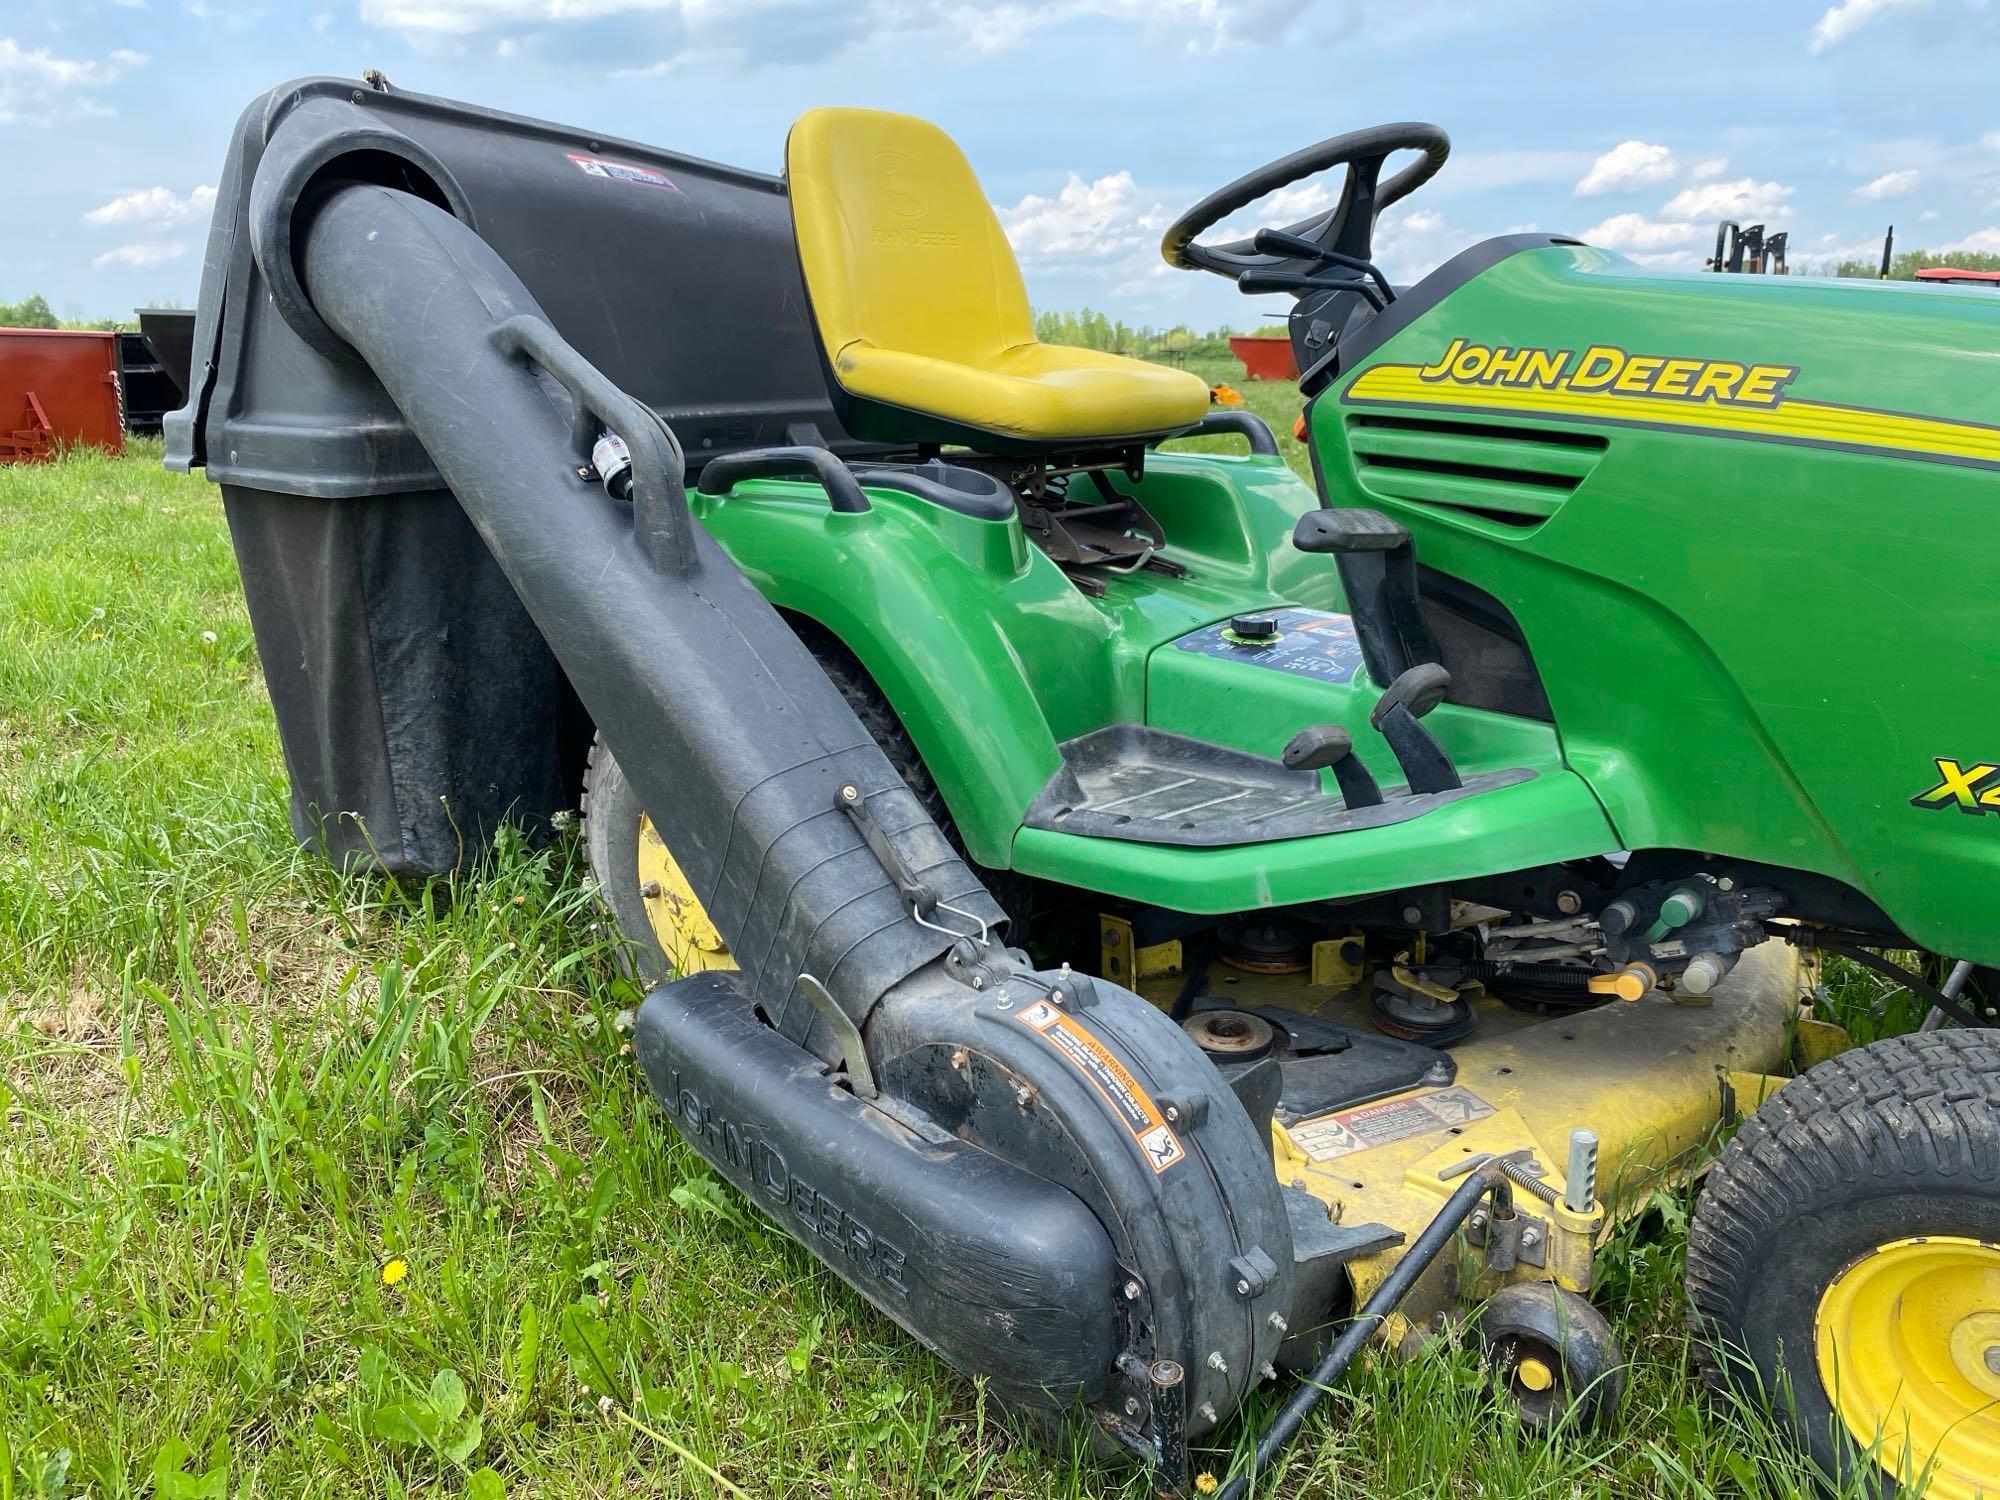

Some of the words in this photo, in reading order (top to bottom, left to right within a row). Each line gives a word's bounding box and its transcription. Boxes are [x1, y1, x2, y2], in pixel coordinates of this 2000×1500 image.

[1421, 339, 1572, 387] JOHN
[1567, 345, 1797, 406] DEERE
[1081, 1045, 1101, 1064] BLADE
[1103, 1065, 1125, 1093] THROWN
[1125, 1092, 1149, 1124] OBJECTS
[1094, 1045, 1135, 1089] WARNING
[1359, 1102, 1408, 1118] DANGER
[664, 1068, 753, 1182] JOHN
[759, 1139, 911, 1300] DEERE
